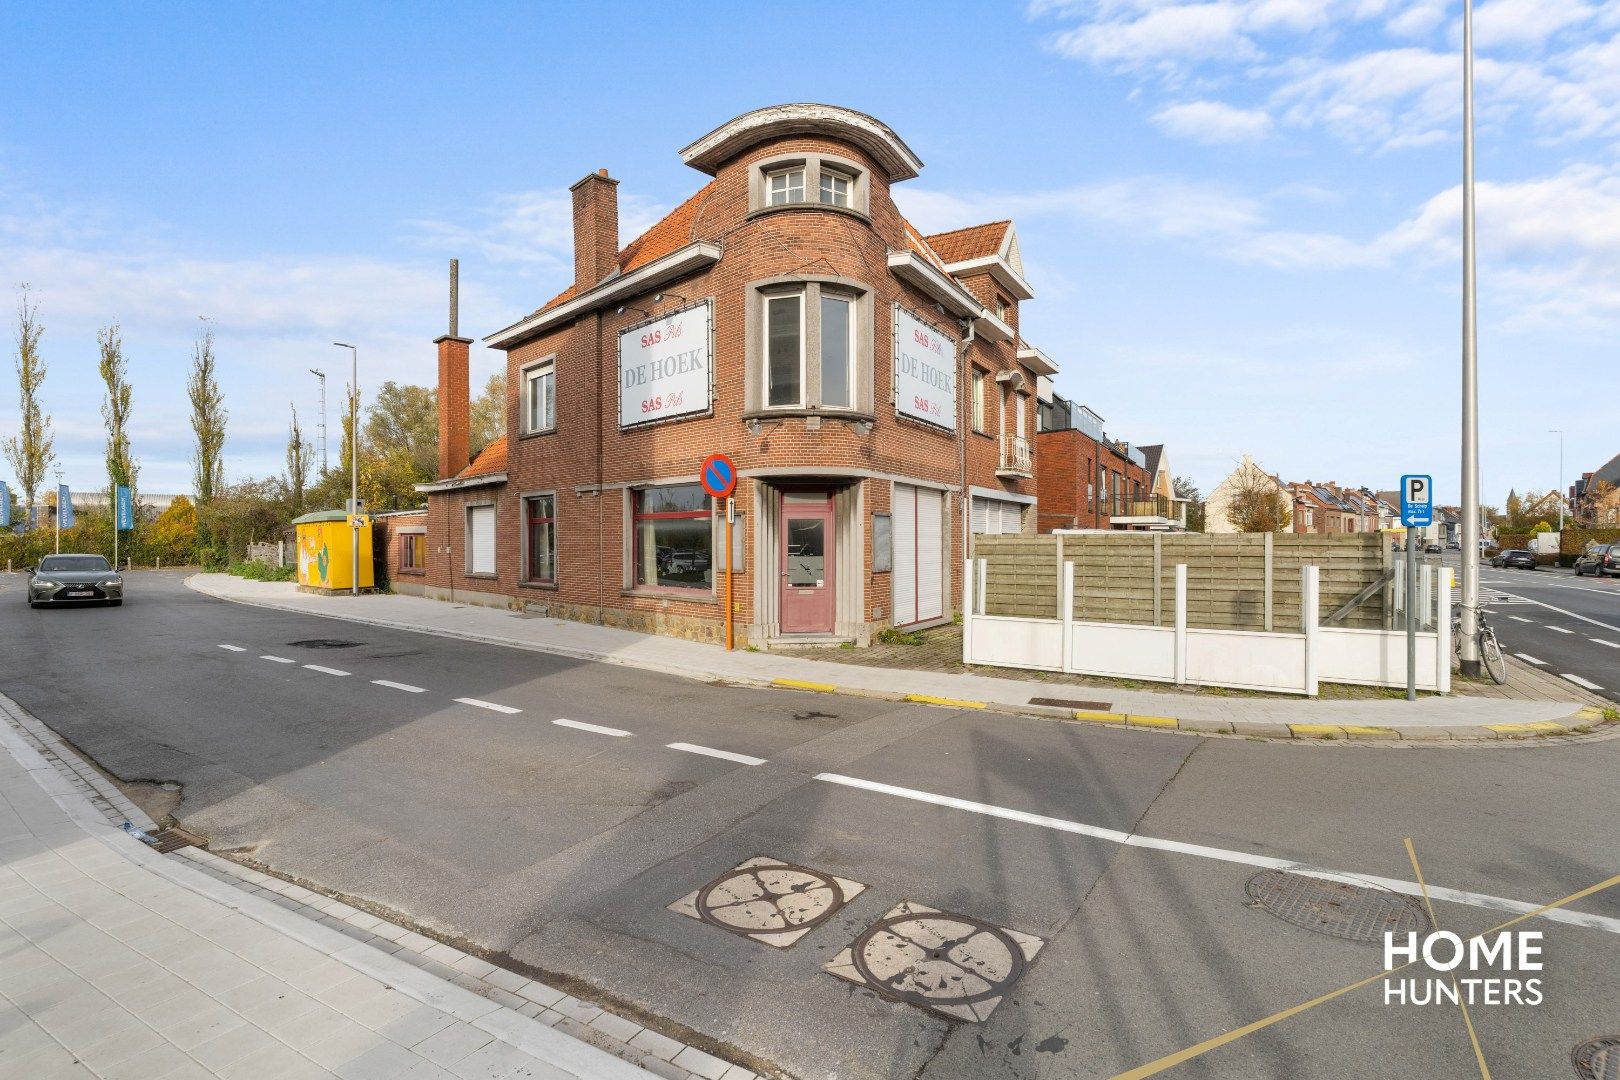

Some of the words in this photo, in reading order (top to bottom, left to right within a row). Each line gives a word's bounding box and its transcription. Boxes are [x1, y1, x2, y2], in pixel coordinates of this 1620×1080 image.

[641, 330, 661, 348] SAS
[914, 329, 929, 348] SAS
[624, 364, 647, 389] DE
[650, 347, 703, 382] HOEK
[901, 352, 919, 379] DE
[921, 361, 952, 394] HOEK
[641, 396, 662, 413] SAS
[914, 395, 929, 412] SAS
[1411, 480, 1424, 501] P
